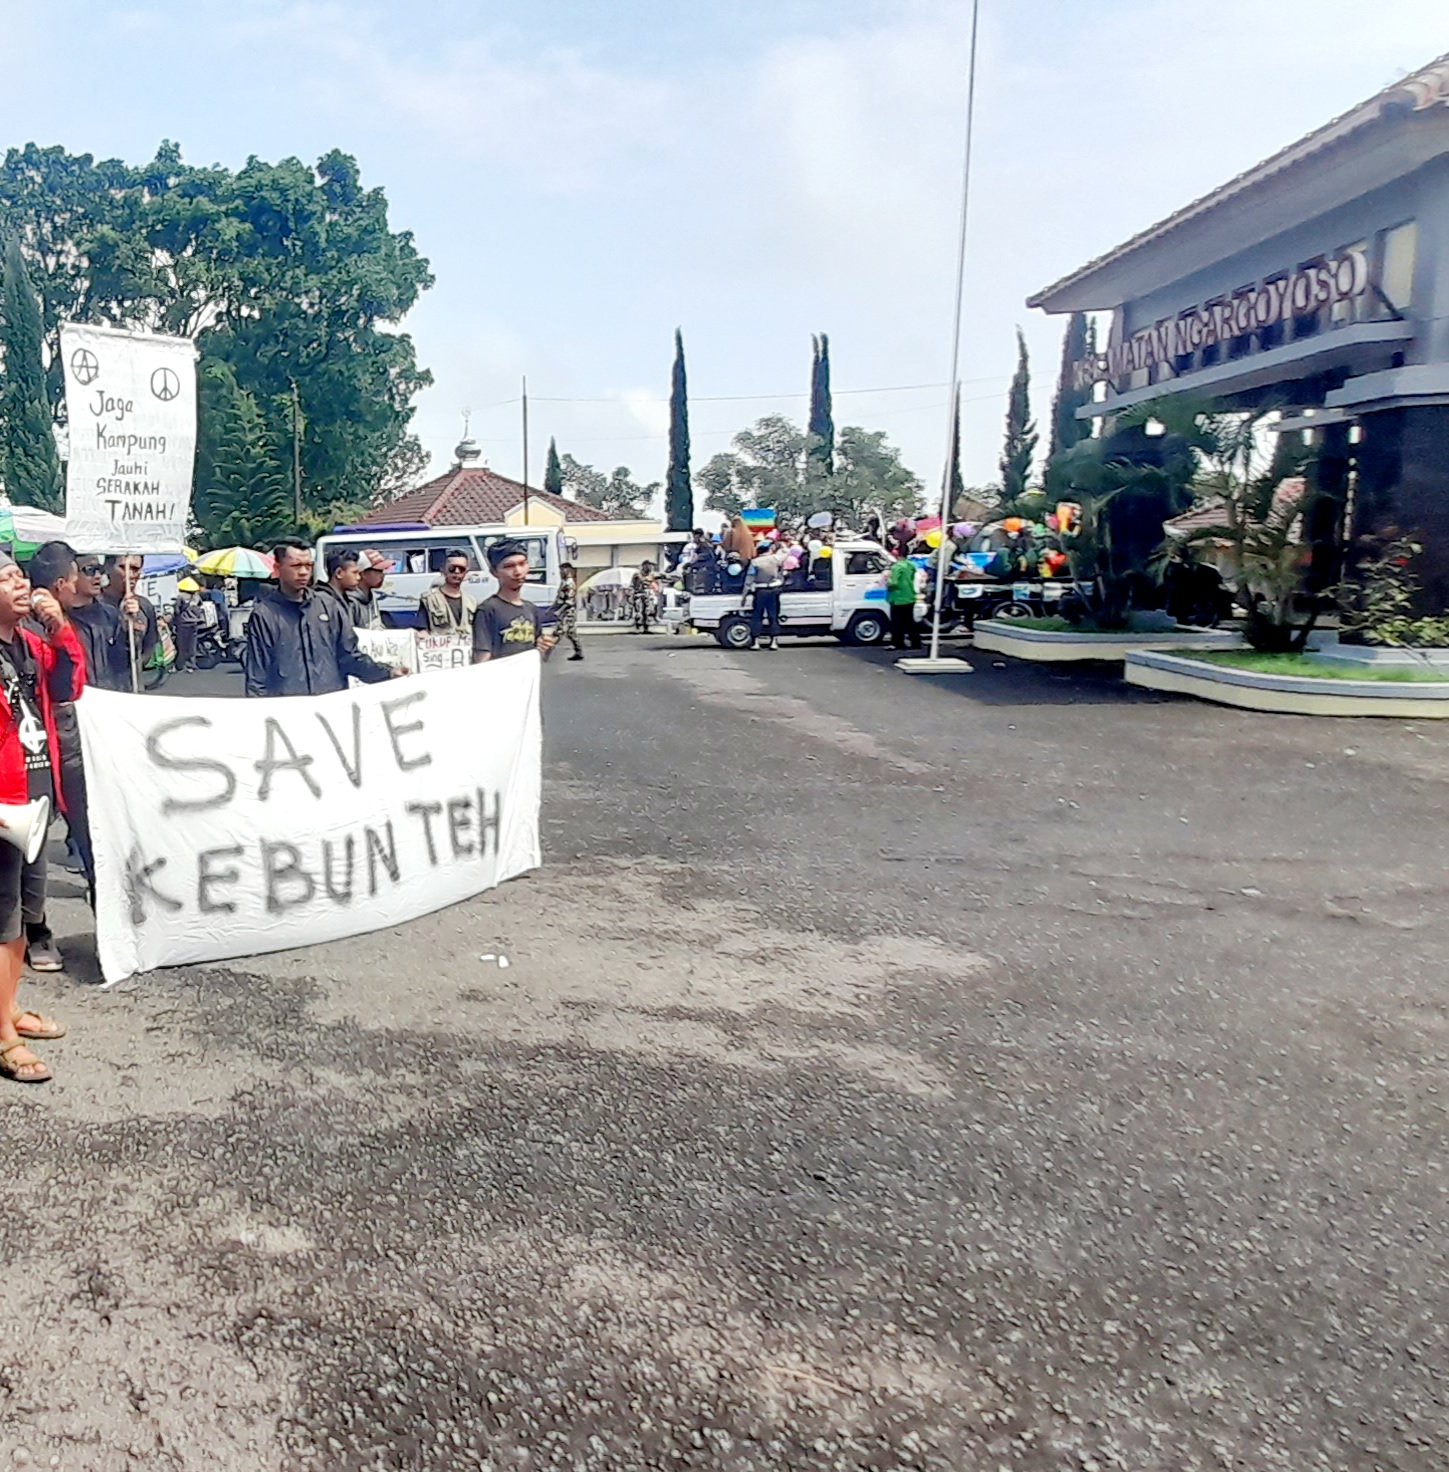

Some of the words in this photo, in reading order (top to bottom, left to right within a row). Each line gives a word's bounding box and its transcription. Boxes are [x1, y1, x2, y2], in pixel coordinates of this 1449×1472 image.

[89, 390, 133, 421] Jaga
[96, 422, 167, 456] Kampung
[110, 459, 149, 477] Jauhi
[96, 477, 161, 496] SERAKAH
[104, 499, 176, 522] TANAH!
[145, 690, 434, 816] SAVE
[125, 820, 401, 927] KEBUN
[406, 786, 501, 867] TEH
